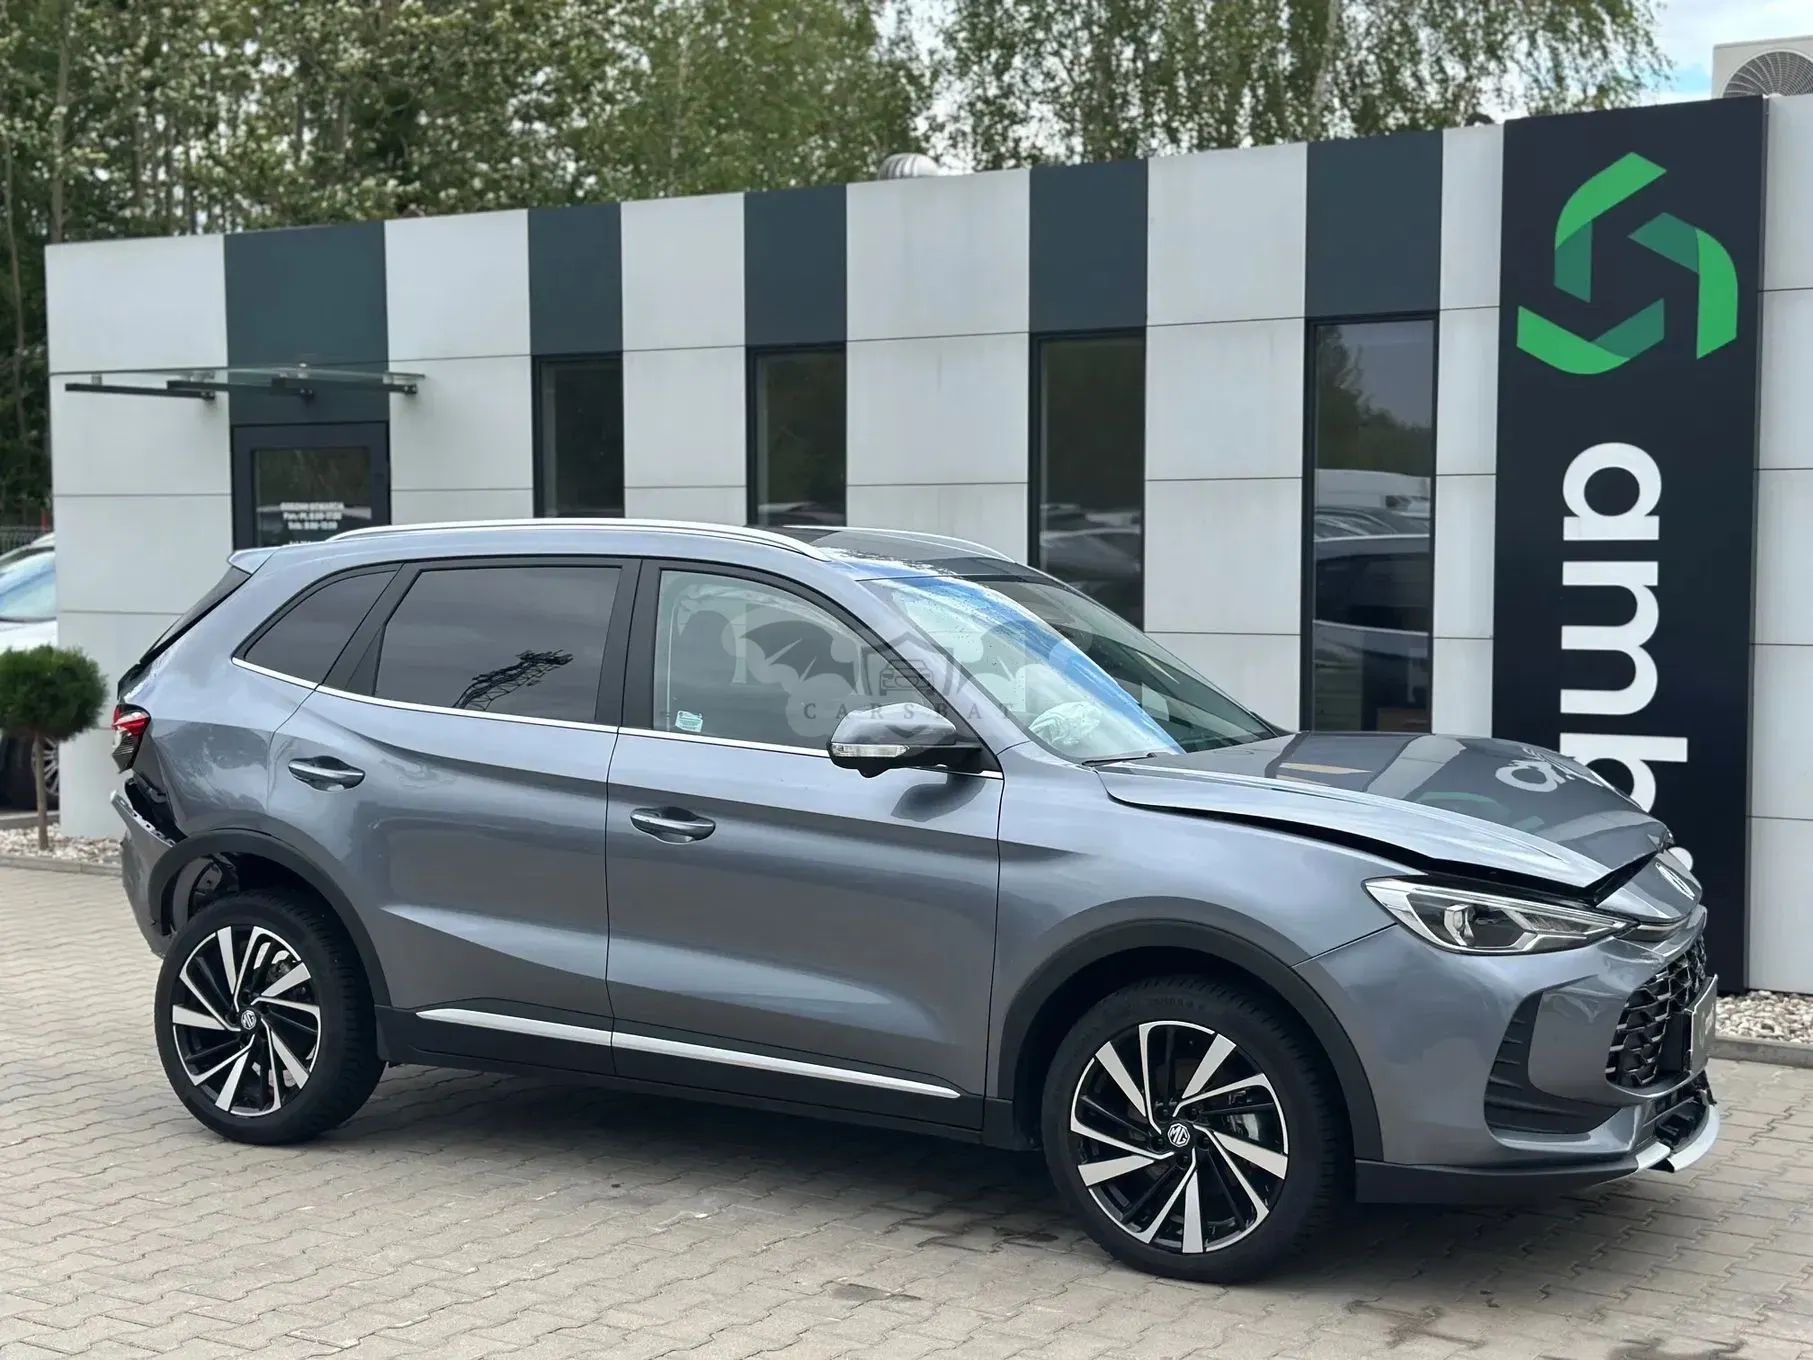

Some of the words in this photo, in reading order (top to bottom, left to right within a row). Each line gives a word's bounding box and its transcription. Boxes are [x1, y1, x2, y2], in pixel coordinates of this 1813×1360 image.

[1560, 442, 1693, 871] amb
[242, 1011, 256, 1029] MG
[1169, 1125, 1189, 1145] MG
